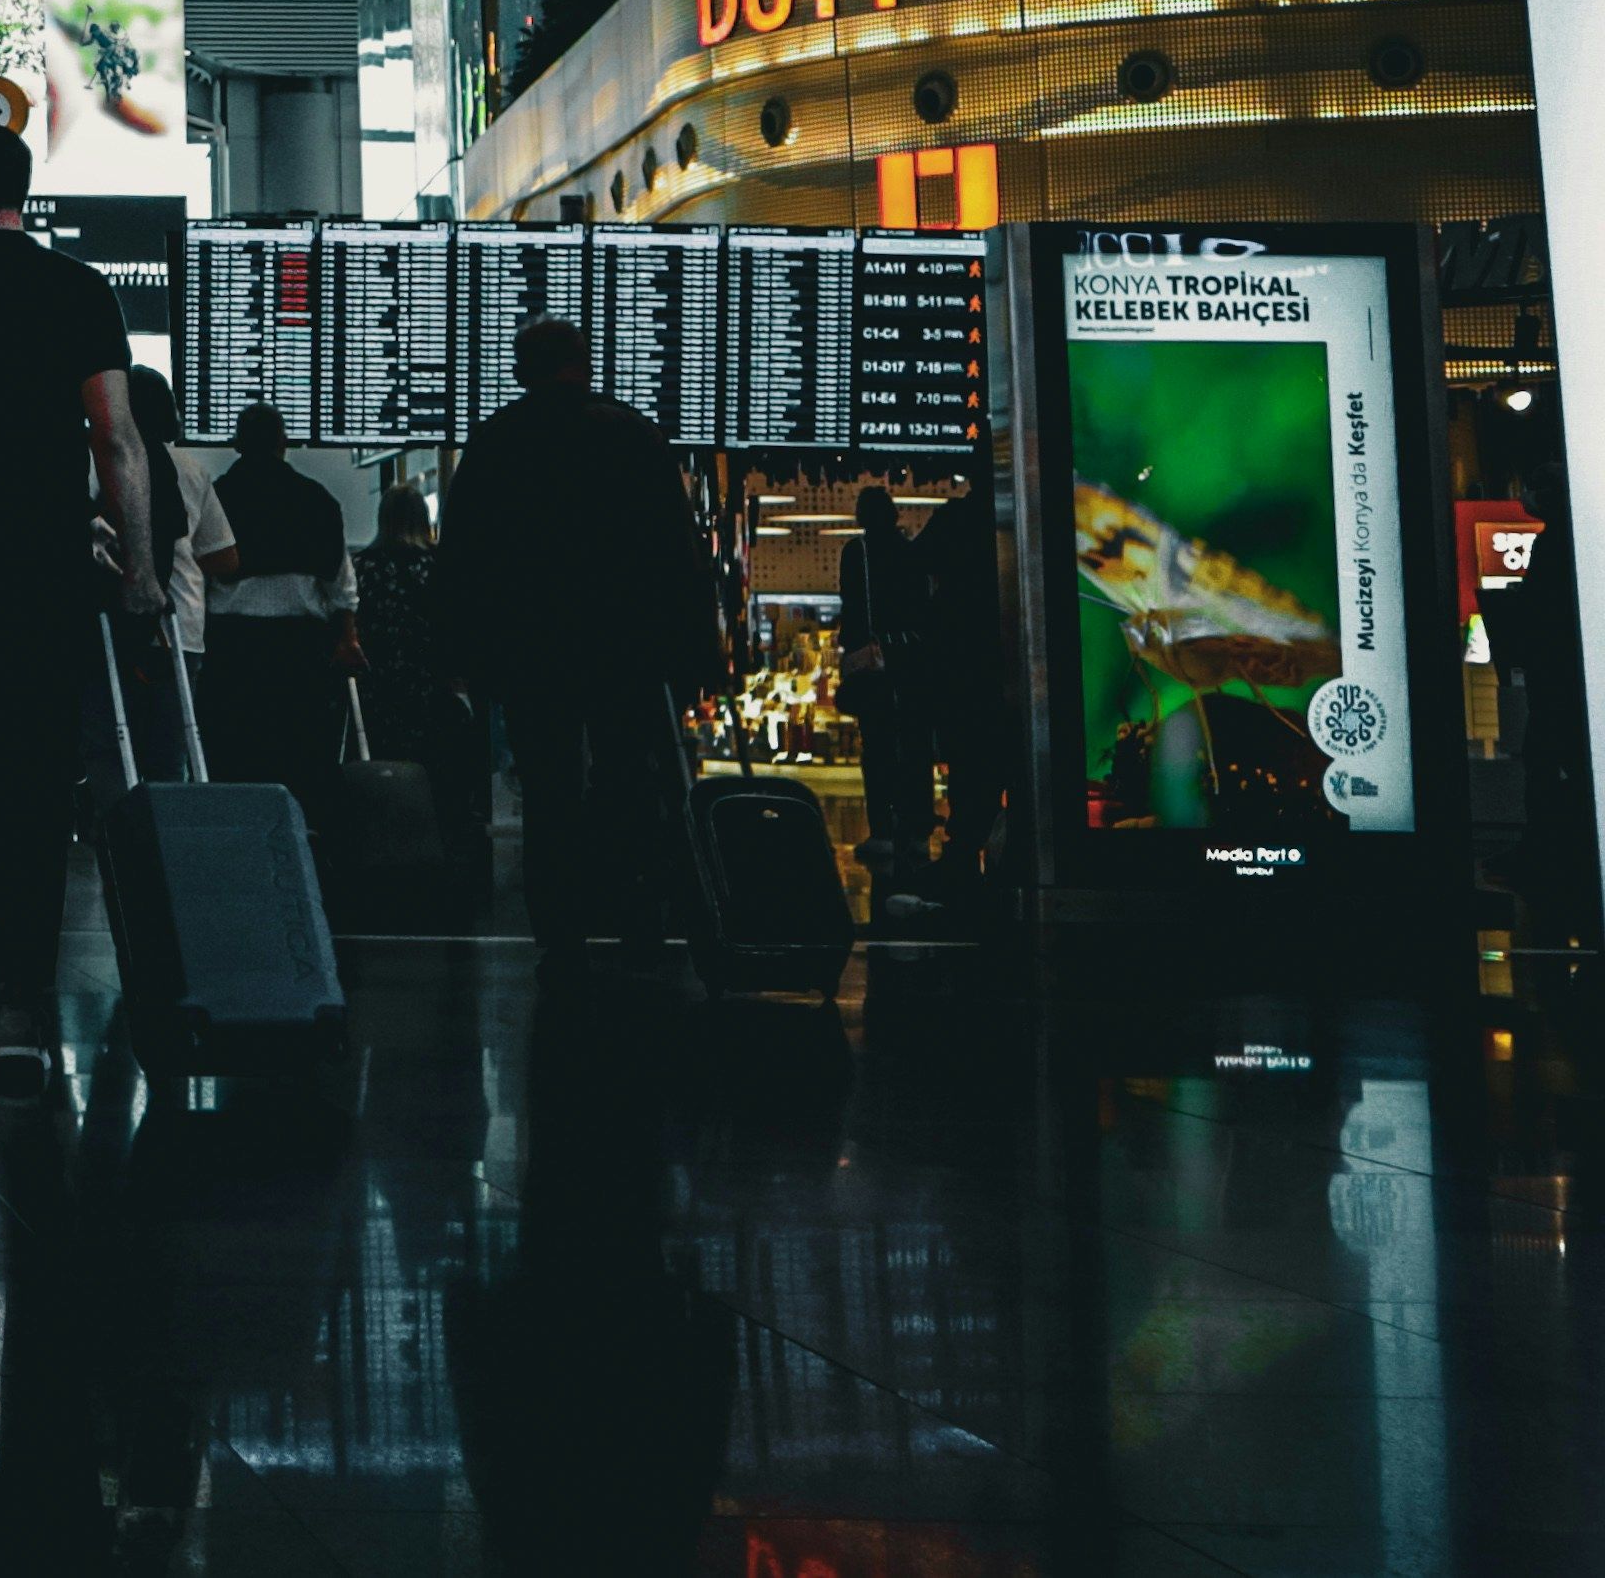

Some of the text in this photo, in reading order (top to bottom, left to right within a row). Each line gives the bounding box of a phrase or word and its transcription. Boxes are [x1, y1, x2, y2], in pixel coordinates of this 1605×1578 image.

[864, 262, 906, 274] A1-A11
[917, 263, 943, 274] 4-10
[1075, 271, 1300, 296] KONYA TROPİKAL
[1075, 297, 1310, 327] KELEBEK BAHÇESİ
[1347, 391, 1376, 651] Mucizeyi Konya'da Keşfet
[1205, 847, 1286, 862] Media Port
